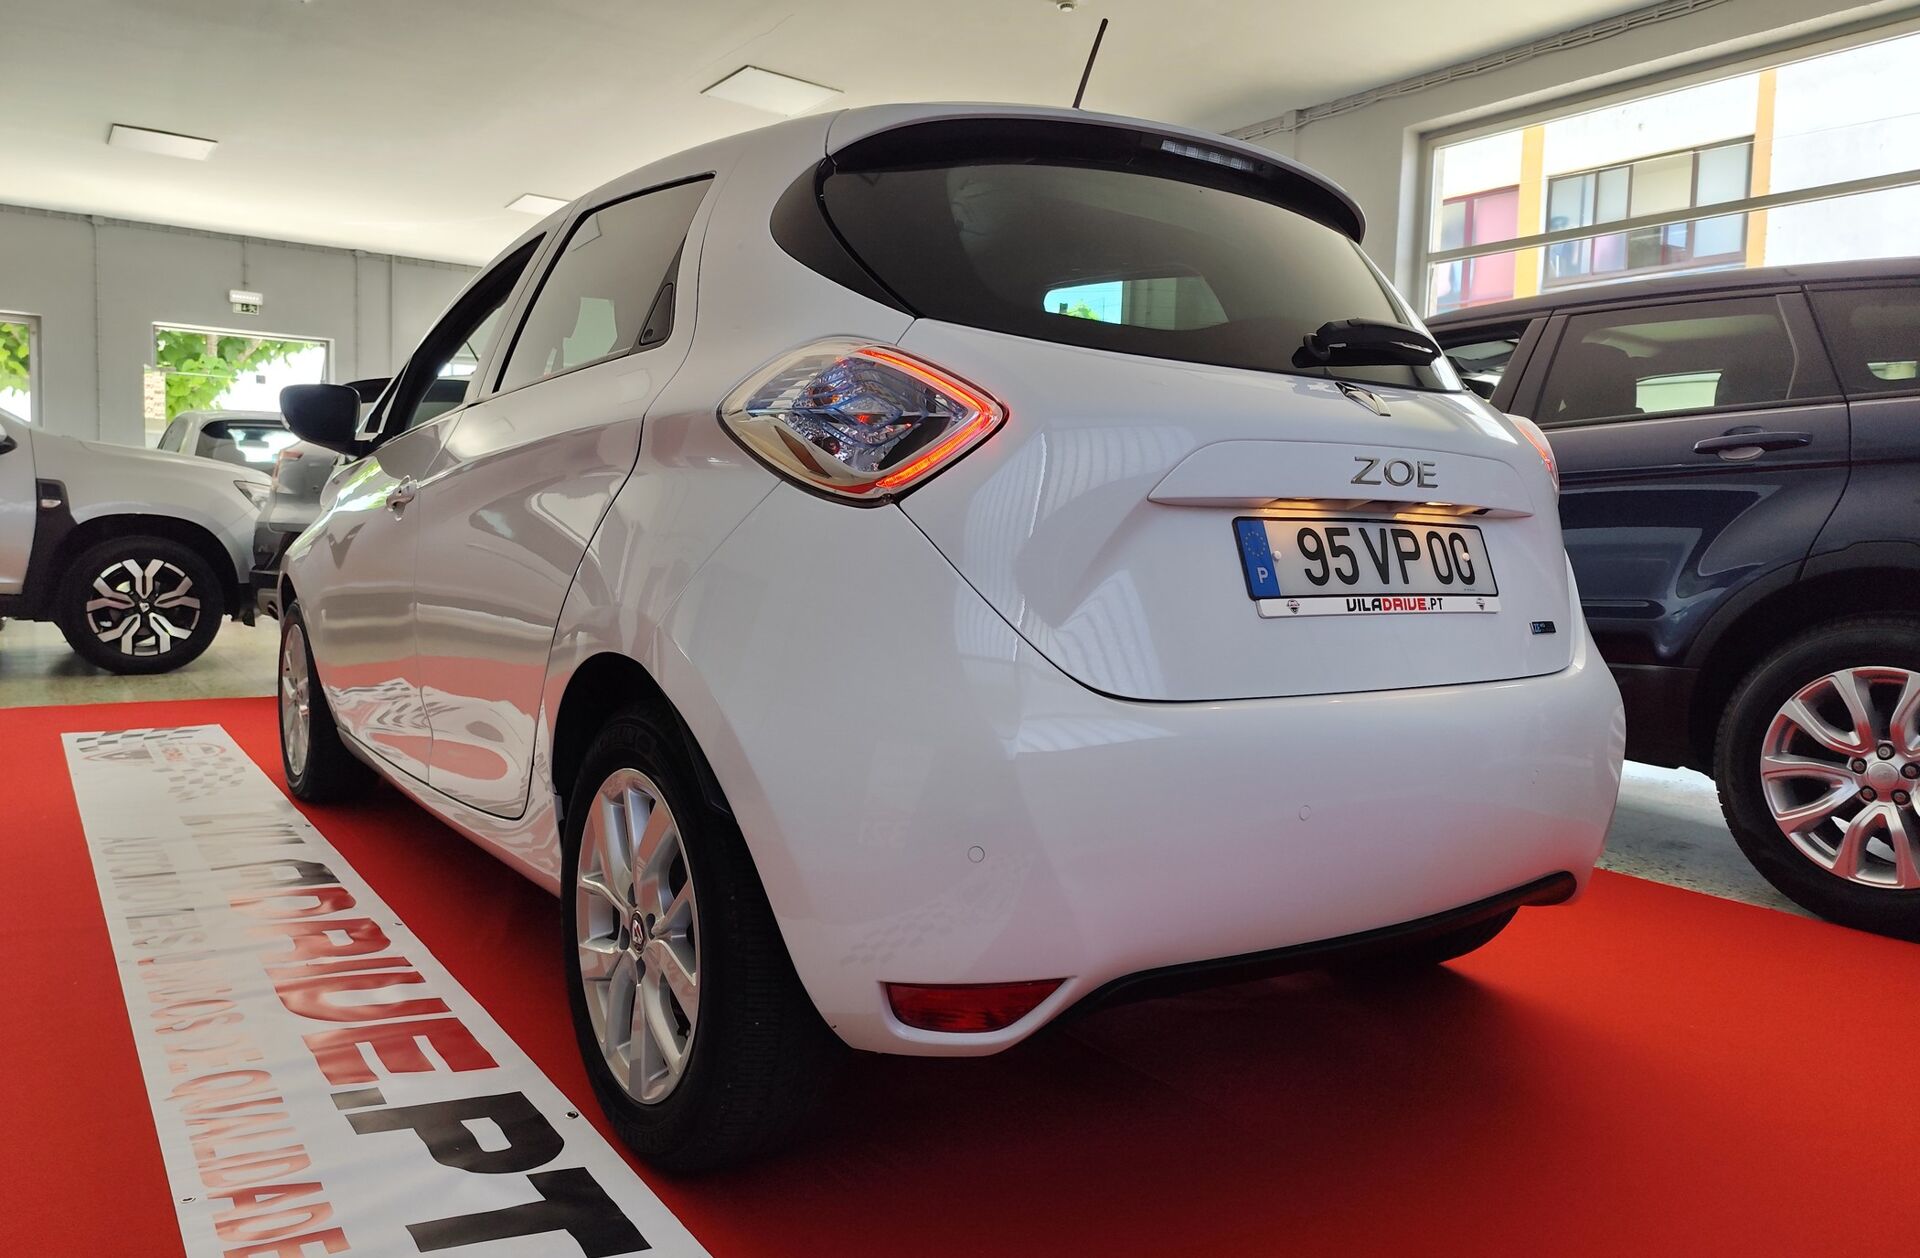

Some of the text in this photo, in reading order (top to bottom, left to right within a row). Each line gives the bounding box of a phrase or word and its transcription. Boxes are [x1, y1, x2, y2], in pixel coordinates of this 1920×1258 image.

[1351, 456, 1438, 488] ZOE
[1257, 567, 1268, 583] P
[136, 949, 245, 1034] UDOS
